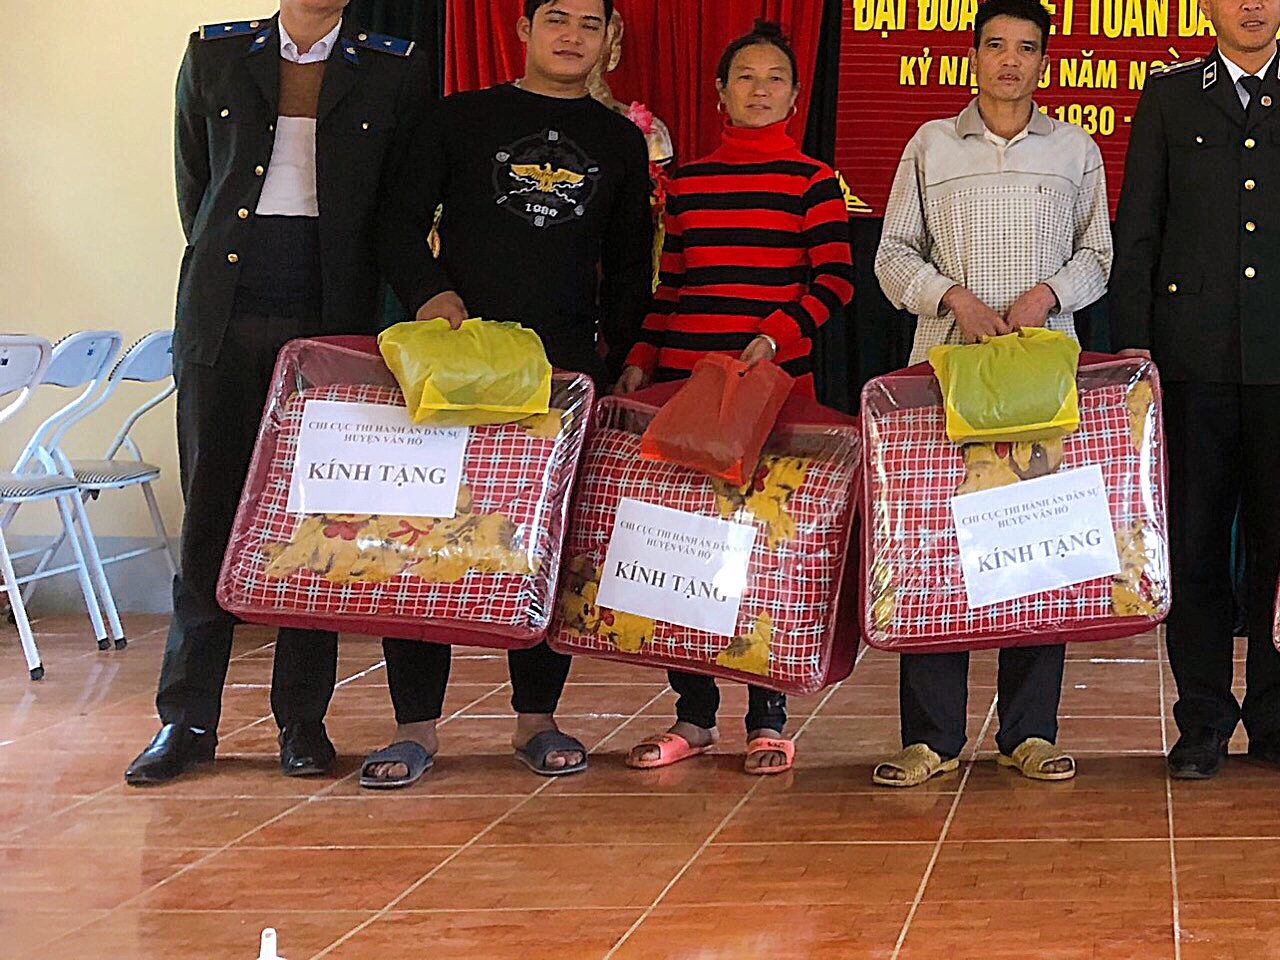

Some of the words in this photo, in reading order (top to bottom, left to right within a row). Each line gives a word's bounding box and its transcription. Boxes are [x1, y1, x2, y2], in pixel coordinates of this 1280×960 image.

[899, 47, 933, 86] KỶ
[1059, 49, 1117, 89] NĂM
[308, 458, 372, 481] KÍNH
[378, 461, 448, 488] TẶNG
[977, 544, 1034, 573] KÍNH
[1039, 528, 1102, 558] TẶNG
[614, 560, 667, 588] KÍNH
